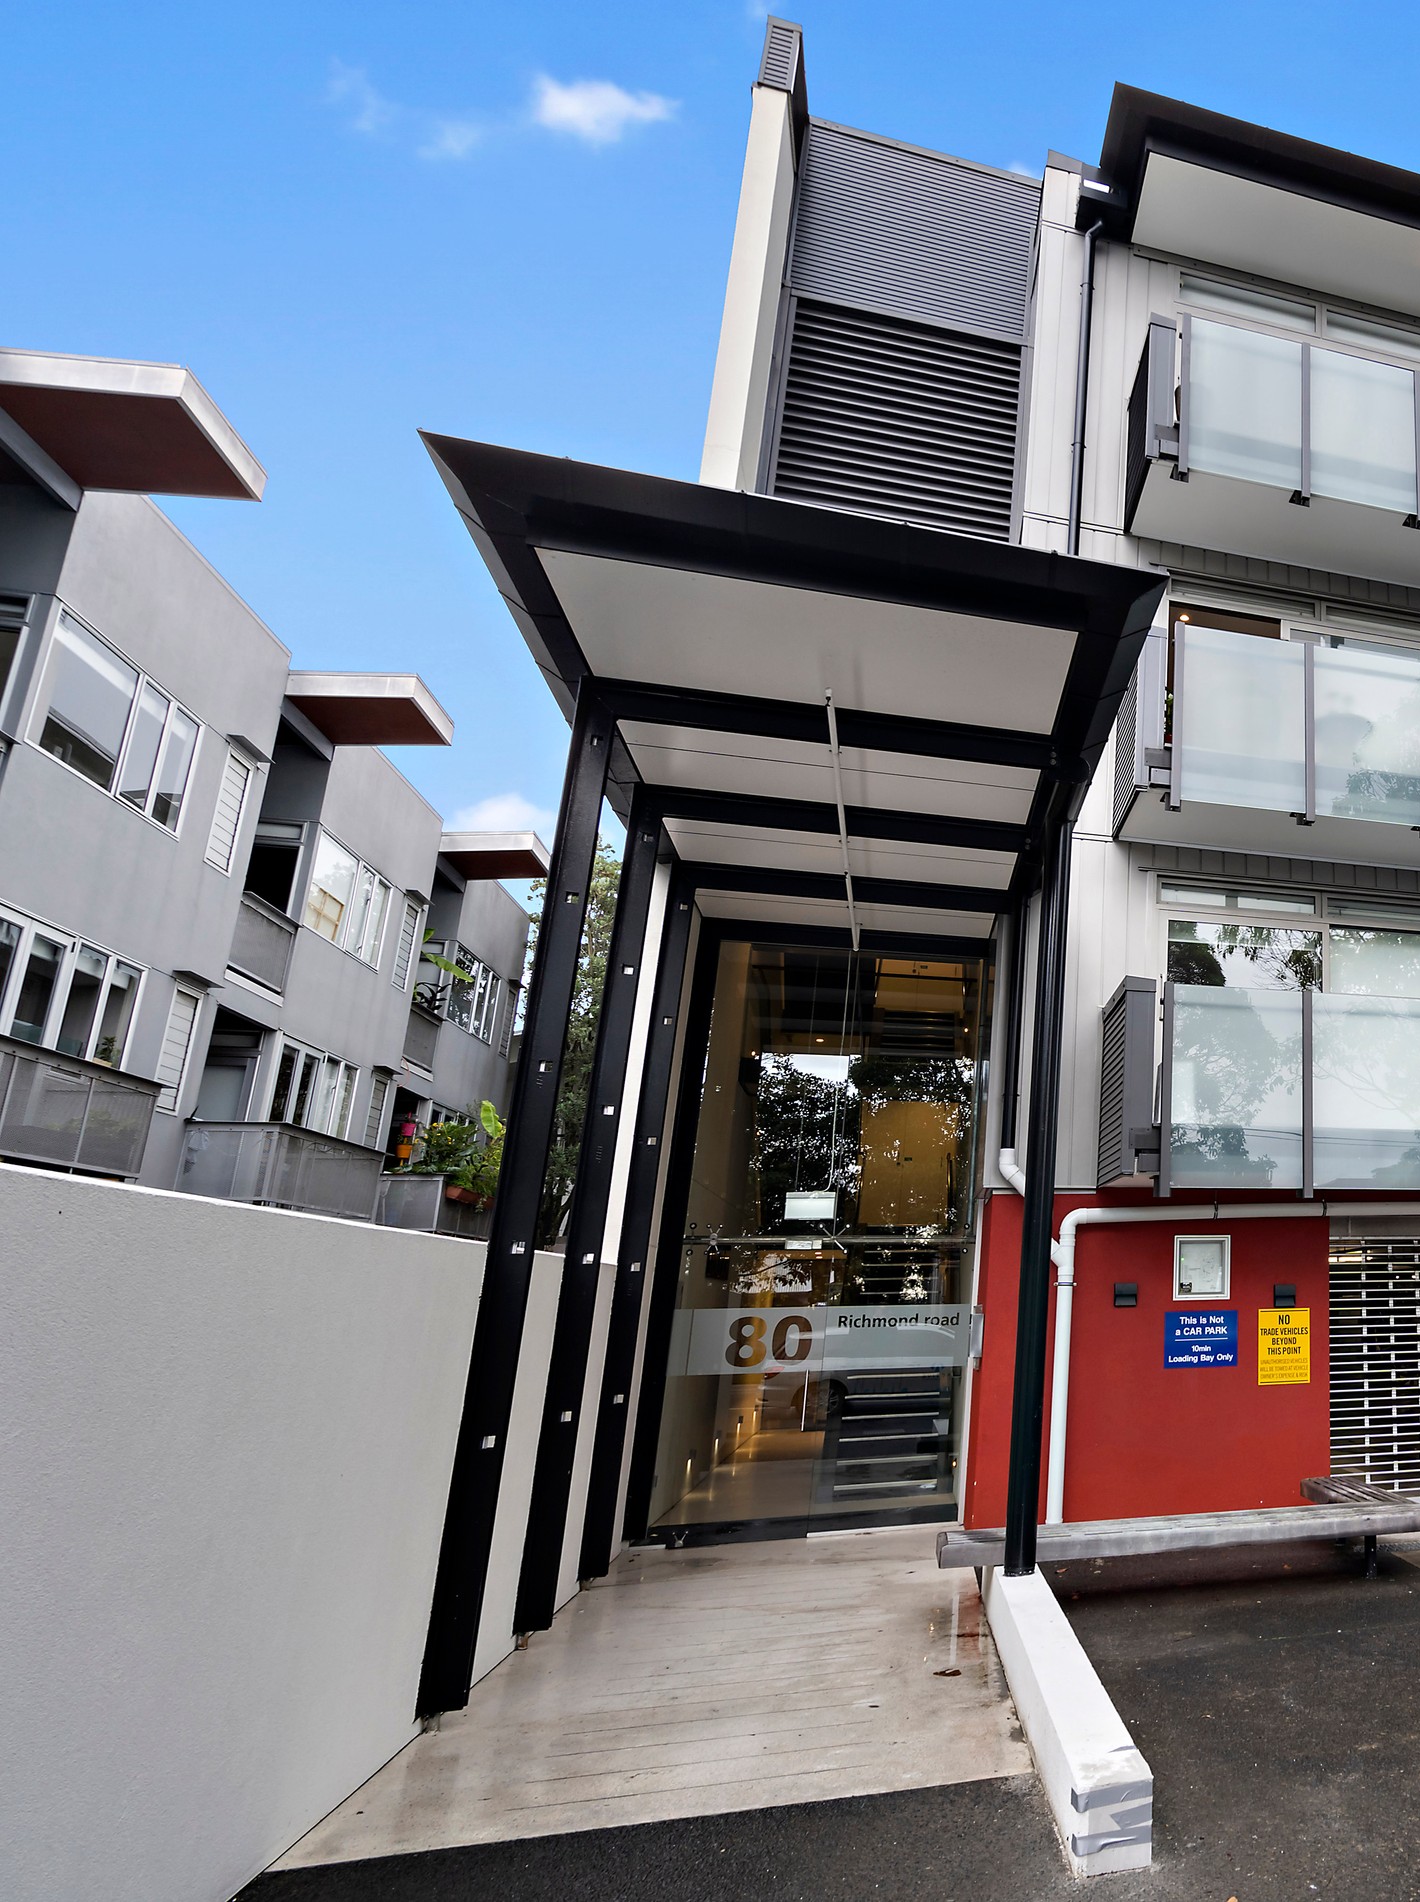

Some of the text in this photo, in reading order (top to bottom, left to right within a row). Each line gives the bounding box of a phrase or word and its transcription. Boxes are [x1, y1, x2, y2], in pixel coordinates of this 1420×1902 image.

[838, 1312, 960, 1328] Richmond road
[1180, 1316, 1197, 1324] This
[1210, 1316, 1224, 1324] Not
[1278, 1314, 1290, 1325] NO
[1183, 1327, 1202, 1335] CAR
[1205, 1326, 1228, 1335] PARK
[1280, 1327, 1308, 1335] VEHICLES
[725, 1315, 813, 1367] 80
[1272, 1337, 1297, 1345] BEYOND
[1283, 1346, 1301, 1355] POINT
[1168, 1353, 1233, 1363] Loading Bay Only
